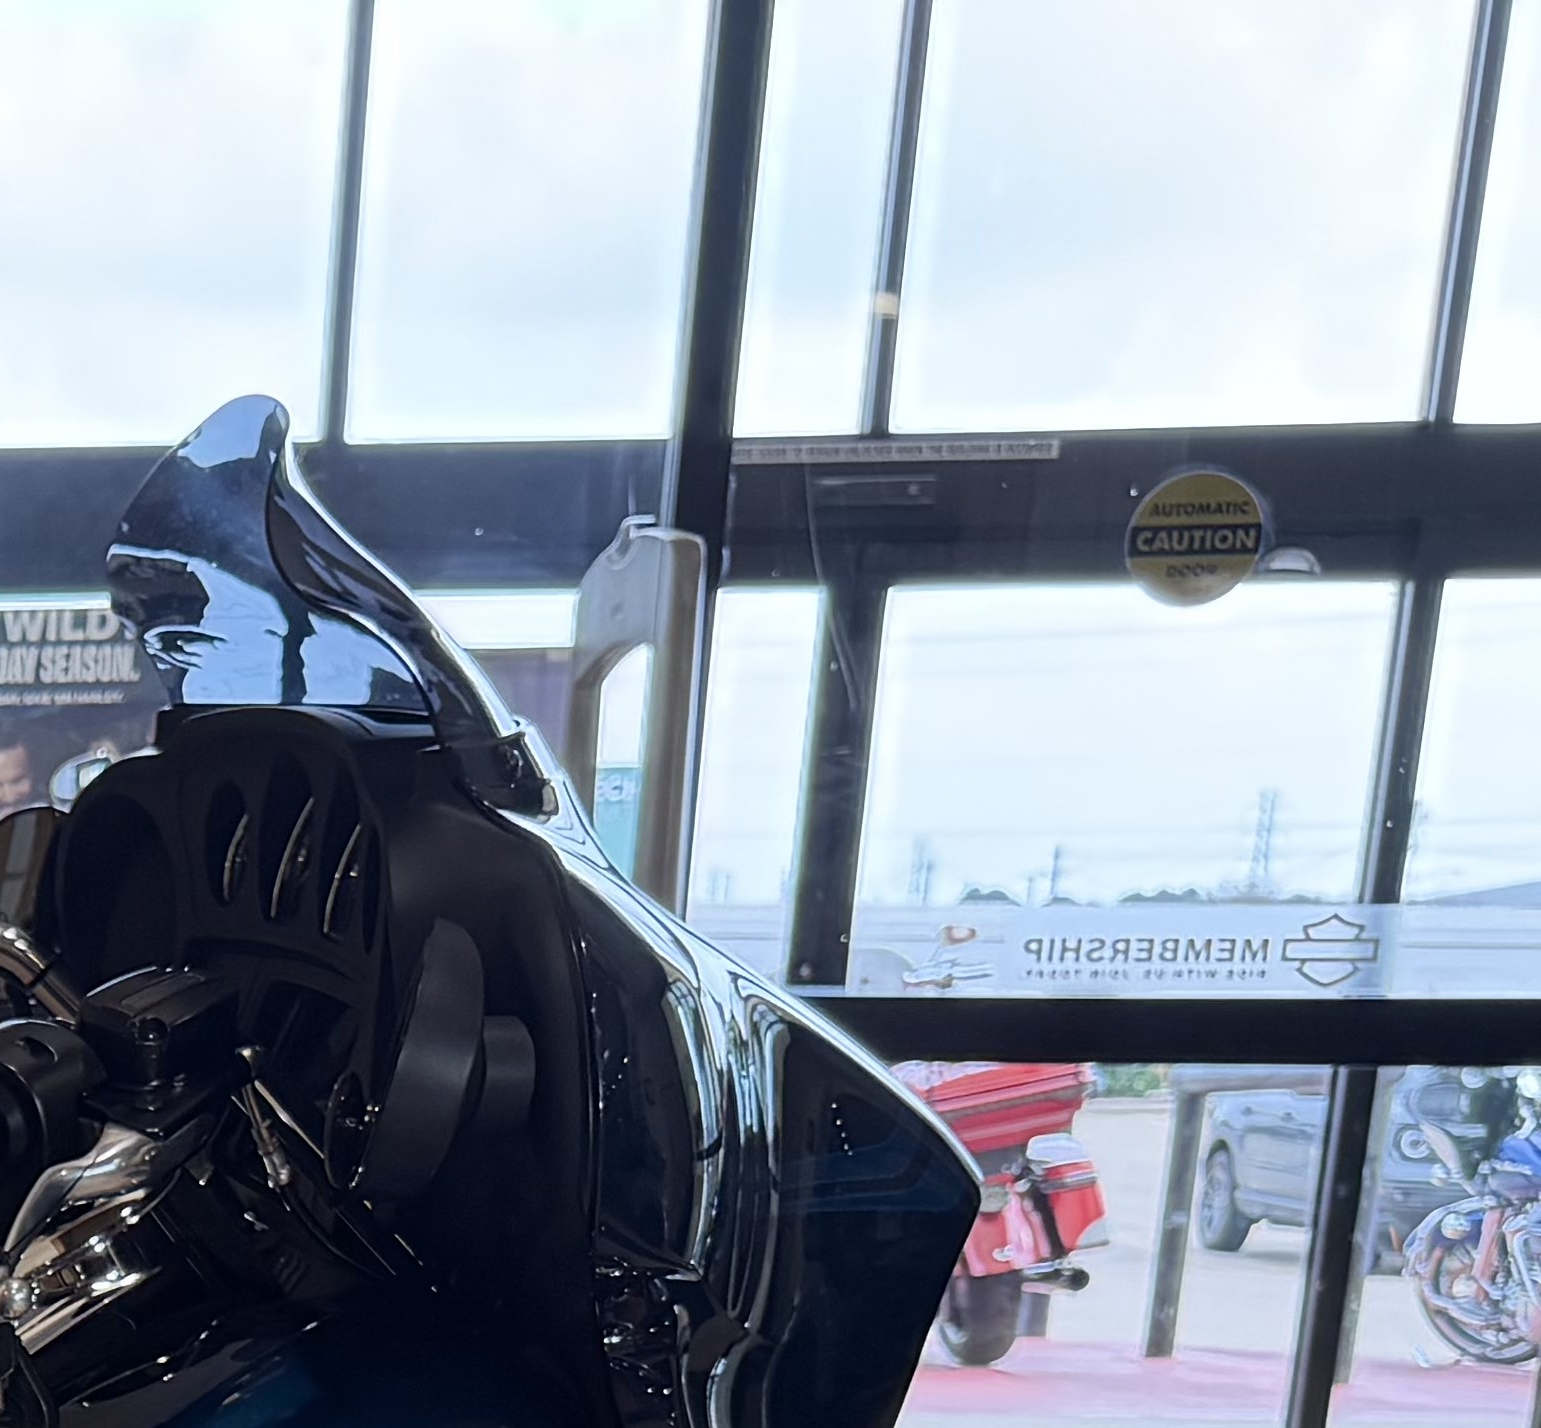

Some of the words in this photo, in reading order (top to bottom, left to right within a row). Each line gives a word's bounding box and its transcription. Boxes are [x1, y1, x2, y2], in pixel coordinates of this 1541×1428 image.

[1149, 501, 1251, 517] AUTOMATIC
[1137, 528, 1257, 552] CAUTION
[3, 609, 120, 642] WILD
